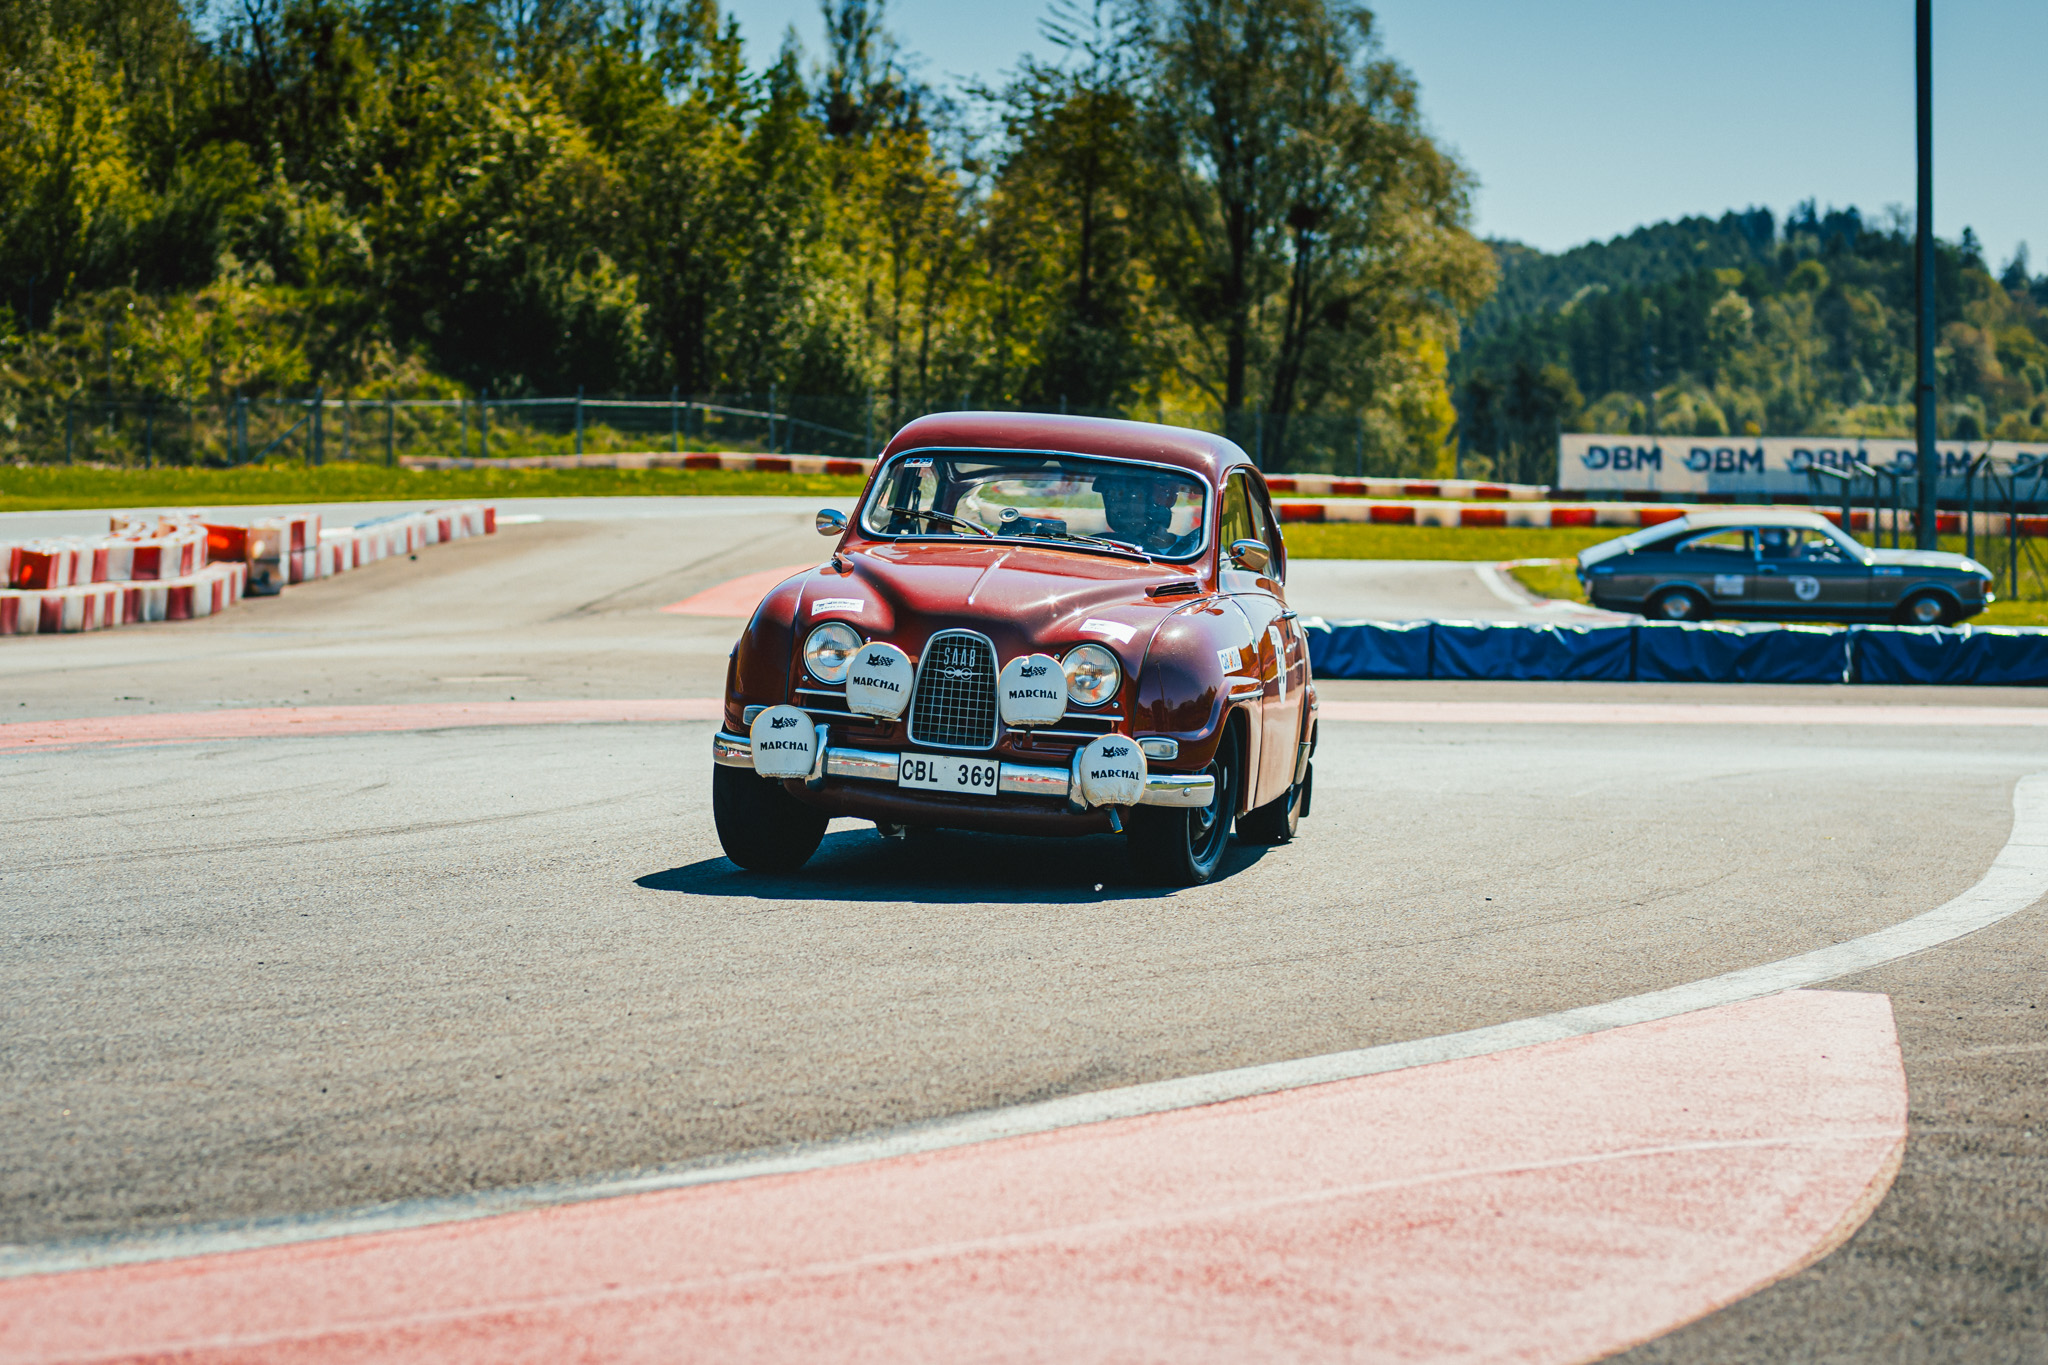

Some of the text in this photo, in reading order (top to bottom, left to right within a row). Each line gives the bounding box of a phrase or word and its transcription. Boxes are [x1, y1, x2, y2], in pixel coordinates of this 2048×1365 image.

[1583, 446, 1663, 472] DBM
[1688, 447, 1766, 474] DBM
[943, 646, 976, 667] SAAB
[853, 676, 900, 693] MARCHAL
[1009, 689, 1058, 700] MARCHAL
[760, 741, 809, 752] MARCHAL
[902, 759, 995, 787] CBL 369
[1091, 769, 1140, 781] MARCHAL
